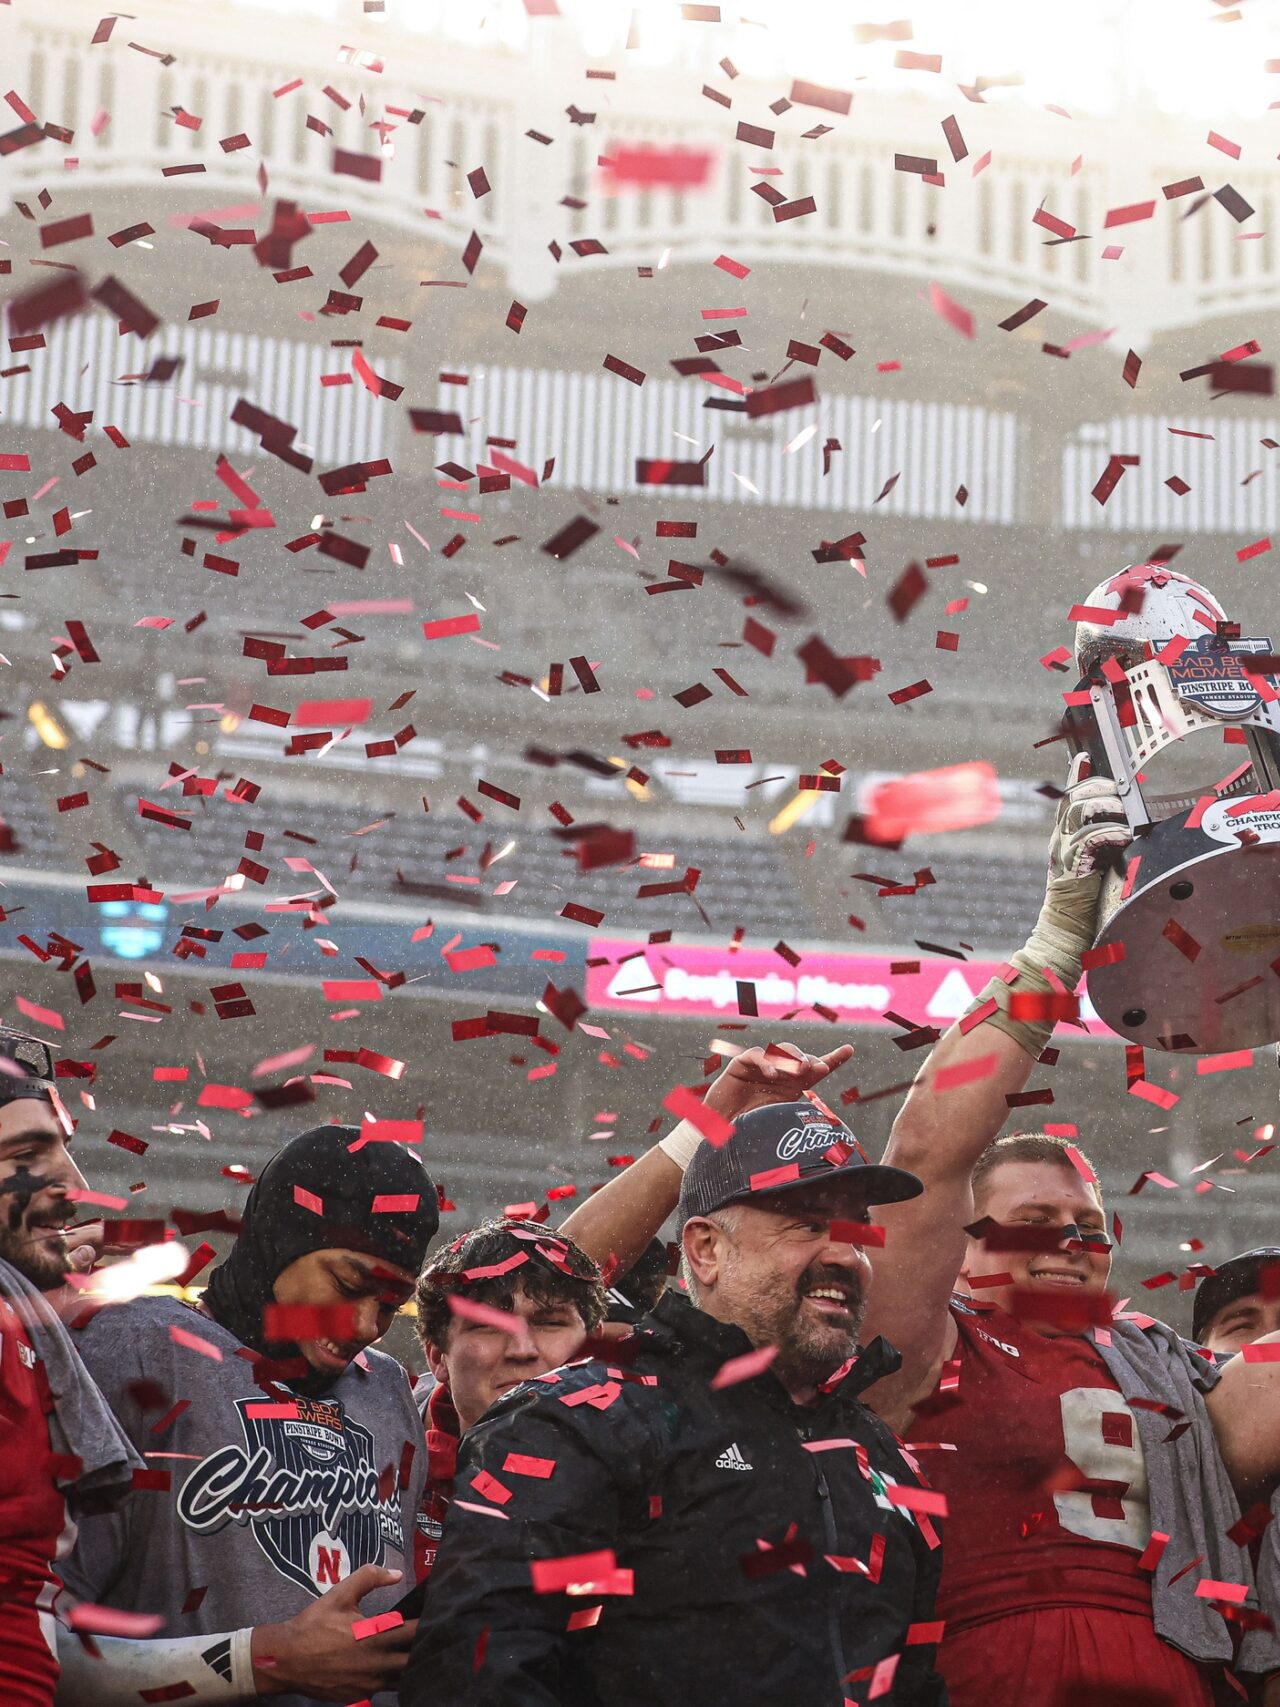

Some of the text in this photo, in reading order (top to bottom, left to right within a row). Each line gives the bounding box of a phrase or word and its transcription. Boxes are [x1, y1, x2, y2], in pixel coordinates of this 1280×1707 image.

[1171, 667, 1250, 678] MOWE
[1181, 681, 1235, 695] PINSTRIPE
[310, 1401, 339, 1417] BOY
[297, 1409, 342, 1431] WERS
[285, 1423, 323, 1438] PINSTRIPE
[715, 1458, 753, 1471] adidas
[177, 1444, 401, 1535] Champios
[316, 1544, 341, 1585] N
